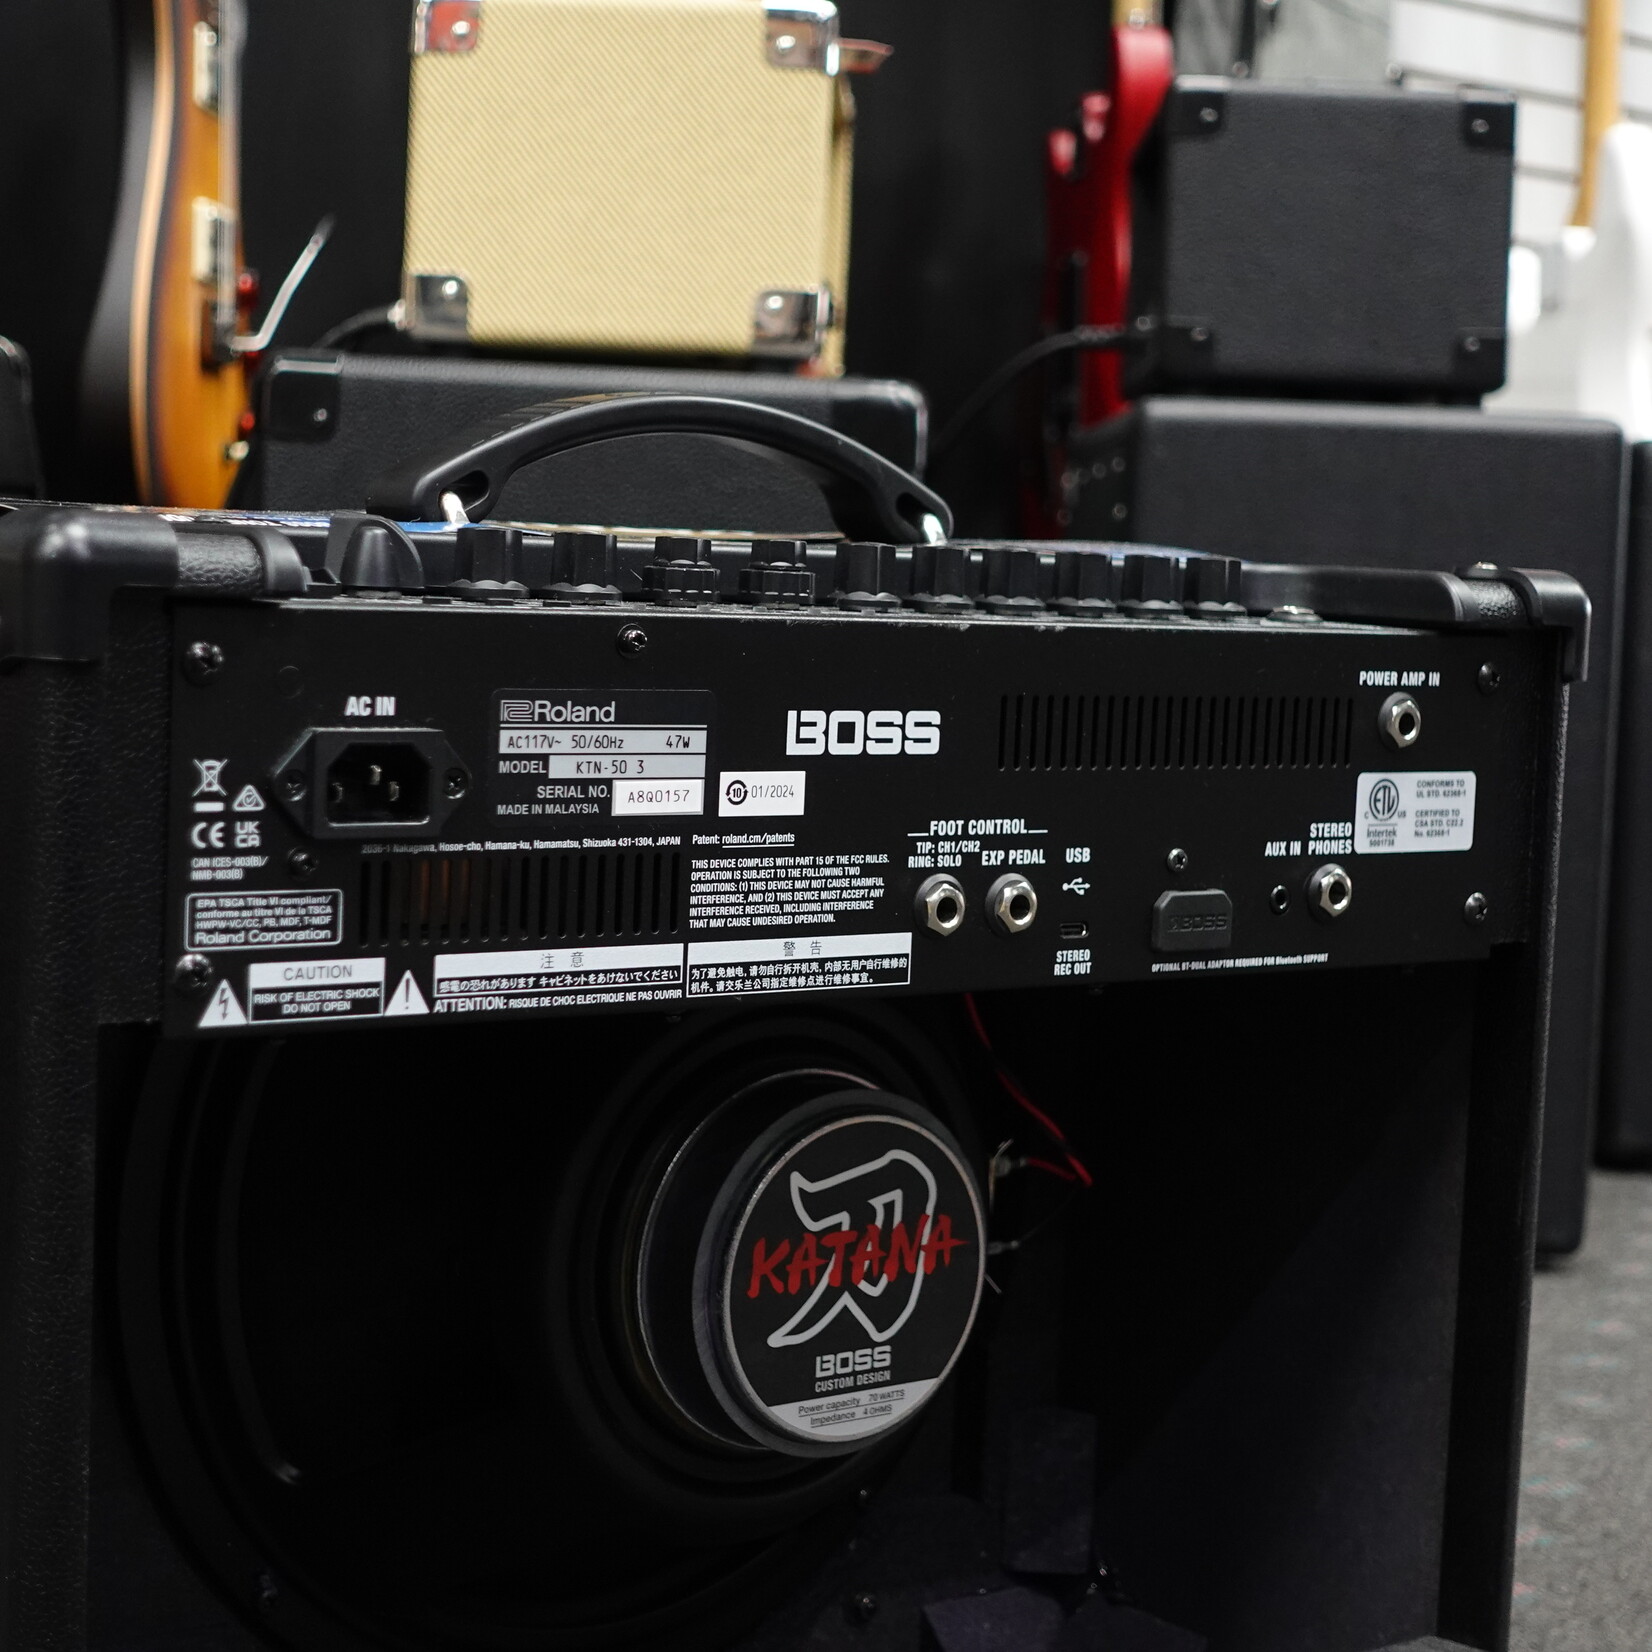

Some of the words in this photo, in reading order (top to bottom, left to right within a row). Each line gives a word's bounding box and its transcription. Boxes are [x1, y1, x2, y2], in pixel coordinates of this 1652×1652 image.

[1359, 670, 1398, 686] POWER
[1402, 671, 1426, 686] AMP
[1429, 672, 1440, 686] IN
[344, 696, 372, 716] AC
[376, 696, 396, 716] IN
[534, 700, 616, 722] Roland
[786, 710, 940, 755] BOSS
[571, 735, 624, 748] 50/60Hz
[666, 736, 690, 748] 47W
[499, 760, 546, 774] MODEL
[576, 760, 628, 774] KTN-50
[637, 760, 644, 774] 3
[1416, 780, 1454, 788] CONFORMS
[537, 786, 584, 798] SERIAL
[586, 786, 610, 798] NO.
[751, 784, 795, 800] 01/2024
[498, 805, 530, 814] MADE
[532, 804, 543, 814] IN
[545, 804, 600, 814] MALAYSIA
[1415, 810, 1449, 818] CERTIFIED
[191, 822, 226, 848] CE
[234, 821, 260, 834] UK
[930, 820, 964, 836] FOOT
[968, 819, 1028, 834] CONTROL
[1310, 822, 1352, 838] STEREO
[1367, 828, 1397, 838] Intertek
[234, 834, 260, 848] CA
[440, 842, 484, 852] Hosoe-cho,
[485, 840, 532, 850] Hamana-ku,
[534, 839, 581, 850] Hamamatsu,
[582, 838, 616, 848] Shizuoka
[618, 837, 654, 847] 431-1304,
[656, 836, 680, 846] JAPAN
[692, 834, 720, 844] Patent:
[722, 832, 795, 846] roland.cm/patents
[916, 842, 935, 854] TIP:
[938, 840, 980, 853] CH1/CH2
[1265, 841, 1287, 856] AUX
[1290, 841, 1301, 856] IN
[1308, 840, 1352, 856] PHONES
[192, 857, 210, 868] CAN
[692, 860, 708, 869] THIS
[710, 858, 736, 868] DEVICE
[738, 858, 774, 868] COMPLIES
[775, 857, 794, 866] WITH
[795, 856, 814, 866] PART
[816, 856, 824, 865] 15
[825, 856, 835, 864] OF
[836, 855, 849, 864] THE
[850, 854, 864, 864] FCC
[866, 854, 890, 864] RULES.
[908, 856, 934, 868] RING:
[937, 855, 962, 867] SOLO
[982, 850, 1004, 866] EXP
[1008, 849, 1046, 864] PEDAL
[1066, 848, 1090, 862] USB
[691, 870, 732, 880] OPERATION
[734, 870, 741, 880] IS
[742, 869, 775, 879] SUBJECT
[776, 869, 786, 878] TO
[787, 868, 801, 878] THE
[802, 867, 843, 877] FOLLOWING
[844, 866, 860, 876] TWO
[690, 882, 738, 893] CONDITIONS:
[738, 882, 748, 892] (1)
[750, 882, 766, 890] THIS
[768, 880, 794, 890] DEVICE
[794, 880, 810, 889] MAY
[811, 879, 826, 888] NOT
[827, 878, 850, 888] CAUSE
[851, 877, 884, 887] HARMFUL
[197, 899, 216, 908] EPA
[219, 898, 245, 907] TSCA
[247, 897, 267, 906] Title
[269, 897, 279, 906] VI
[690, 895, 746, 905] INTERFERENCE,
[748, 894, 764, 903] AND
[764, 892, 775, 902] (2)
[776, 892, 792, 902] THIS
[794, 892, 820, 901] DEVICE
[820, 890, 840, 900] MUST
[842, 890, 868, 899] ACCEPT
[870, 889, 884, 898] ANY
[197, 910, 240, 919] conforme
[254, 908, 273, 917] titre
[286, 907, 296, 915] de
[308, 906, 332, 914] TSCA
[690, 906, 744, 916] INTERFERENCE
[746, 905, 782, 915] RECEIVED,
[783, 903, 821, 913] INCLUDING
[822, 901, 874, 911] INTERFERENCE
[690, 919, 708, 928] THAT
[710, 918, 725, 927] MAY
[726, 917, 751, 926] CAUSE
[752, 916, 793, 925] UNDESIRED
[794, 914, 836, 924] OPERATION.
[195, 931, 245, 944] Roland
[249, 928, 331, 943] Corporation
[1056, 949, 1090, 962] STEREO
[1152, 963, 1180, 972] OPTIONAL
[1182, 962, 1206, 971] BT-DUAL
[1207, 960, 1234, 969] ADAPTOR
[1235, 957, 1262, 967] REQUIRED
[1264, 956, 1275, 966] FOR
[1276, 955, 1302, 965] Bluetooth
[1303, 953, 1328, 963] SUPPORT
[284, 965, 352, 981] CAUTION
[1054, 964, 1072, 976] REC
[1074, 962, 1092, 974] OUT
[254, 993, 277, 1004] RISK
[280, 992, 294, 1002] OF
[295, 990, 343, 1002] ELECTRIC
[345, 988, 380, 999] SHOCK
[433, 996, 507, 1013] ATTENTION:
[508, 998, 538, 1008] RISQUE
[540, 997, 551, 1006] DE
[552, 995, 576, 1006] CHOC
[577, 993, 624, 1004] ELECTRIQUE
[626, 992, 636, 1002] NE
[638, 991, 652, 1000] PAS
[654, 990, 682, 1000] OUVRIR
[282, 1004, 298, 1014] DO
[300, 1002, 320, 1012] NOT
[323, 1001, 351, 1012] OPEN
[746, 1214, 970, 1298] KATANA
[816, 1345, 891, 1378] BOSS
[815, 1376, 854, 1392] CUSTOM
[856, 1370, 891, 1386] DESIGN
[799, 1404, 823, 1414] Power
[826, 1398, 860, 1410] capacity
[879, 1389, 905, 1400] WATTS
[810, 1412, 856, 1424] Impedance
[869, 1404, 892, 1414] OHMS
